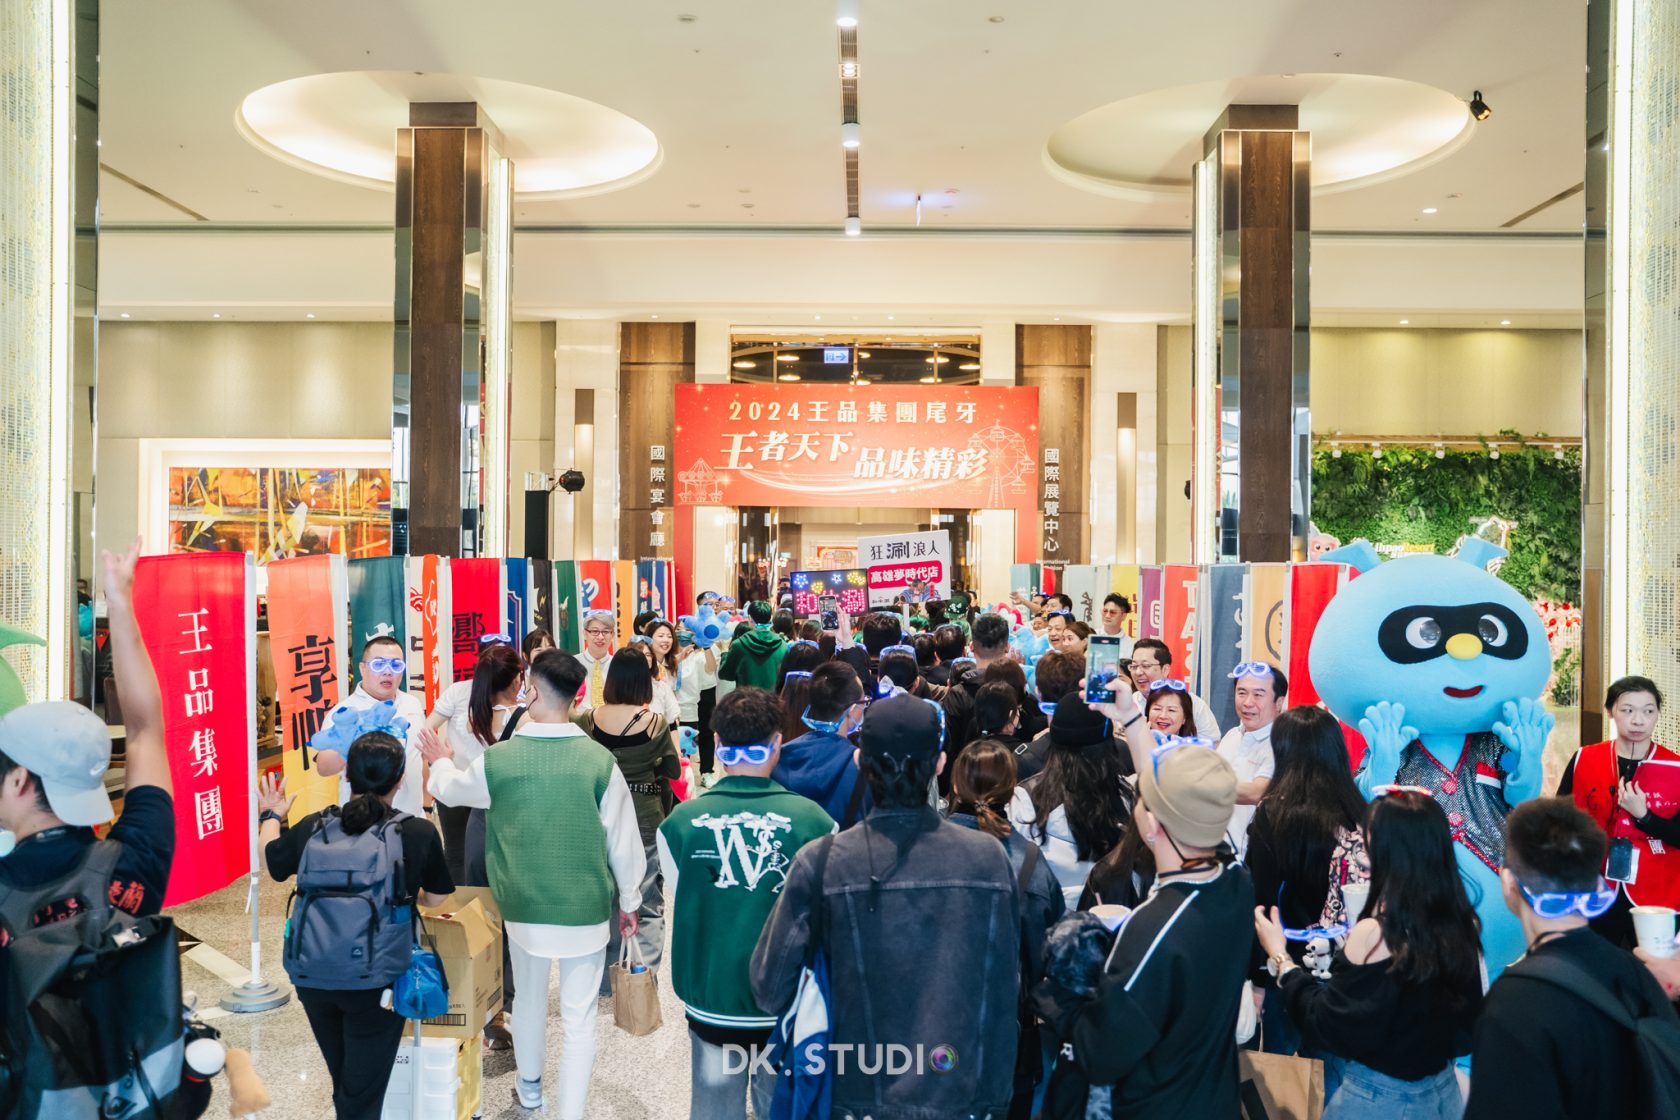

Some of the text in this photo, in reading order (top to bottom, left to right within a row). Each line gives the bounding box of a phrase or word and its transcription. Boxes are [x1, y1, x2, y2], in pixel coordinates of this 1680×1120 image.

[729, 400, 977, 424] 2024王品集團尾牙
[713, 430, 990, 481] 王者天下 品味精彩
[650, 445, 665, 547] 國際宴會廳
[1043, 448, 1060, 552] 國際展覽中心
[870, 540, 940, 560] 狂涮浪人
[870, 565, 940, 584] 高雄夢時代店
[177, 607, 224, 841] 王品集團
